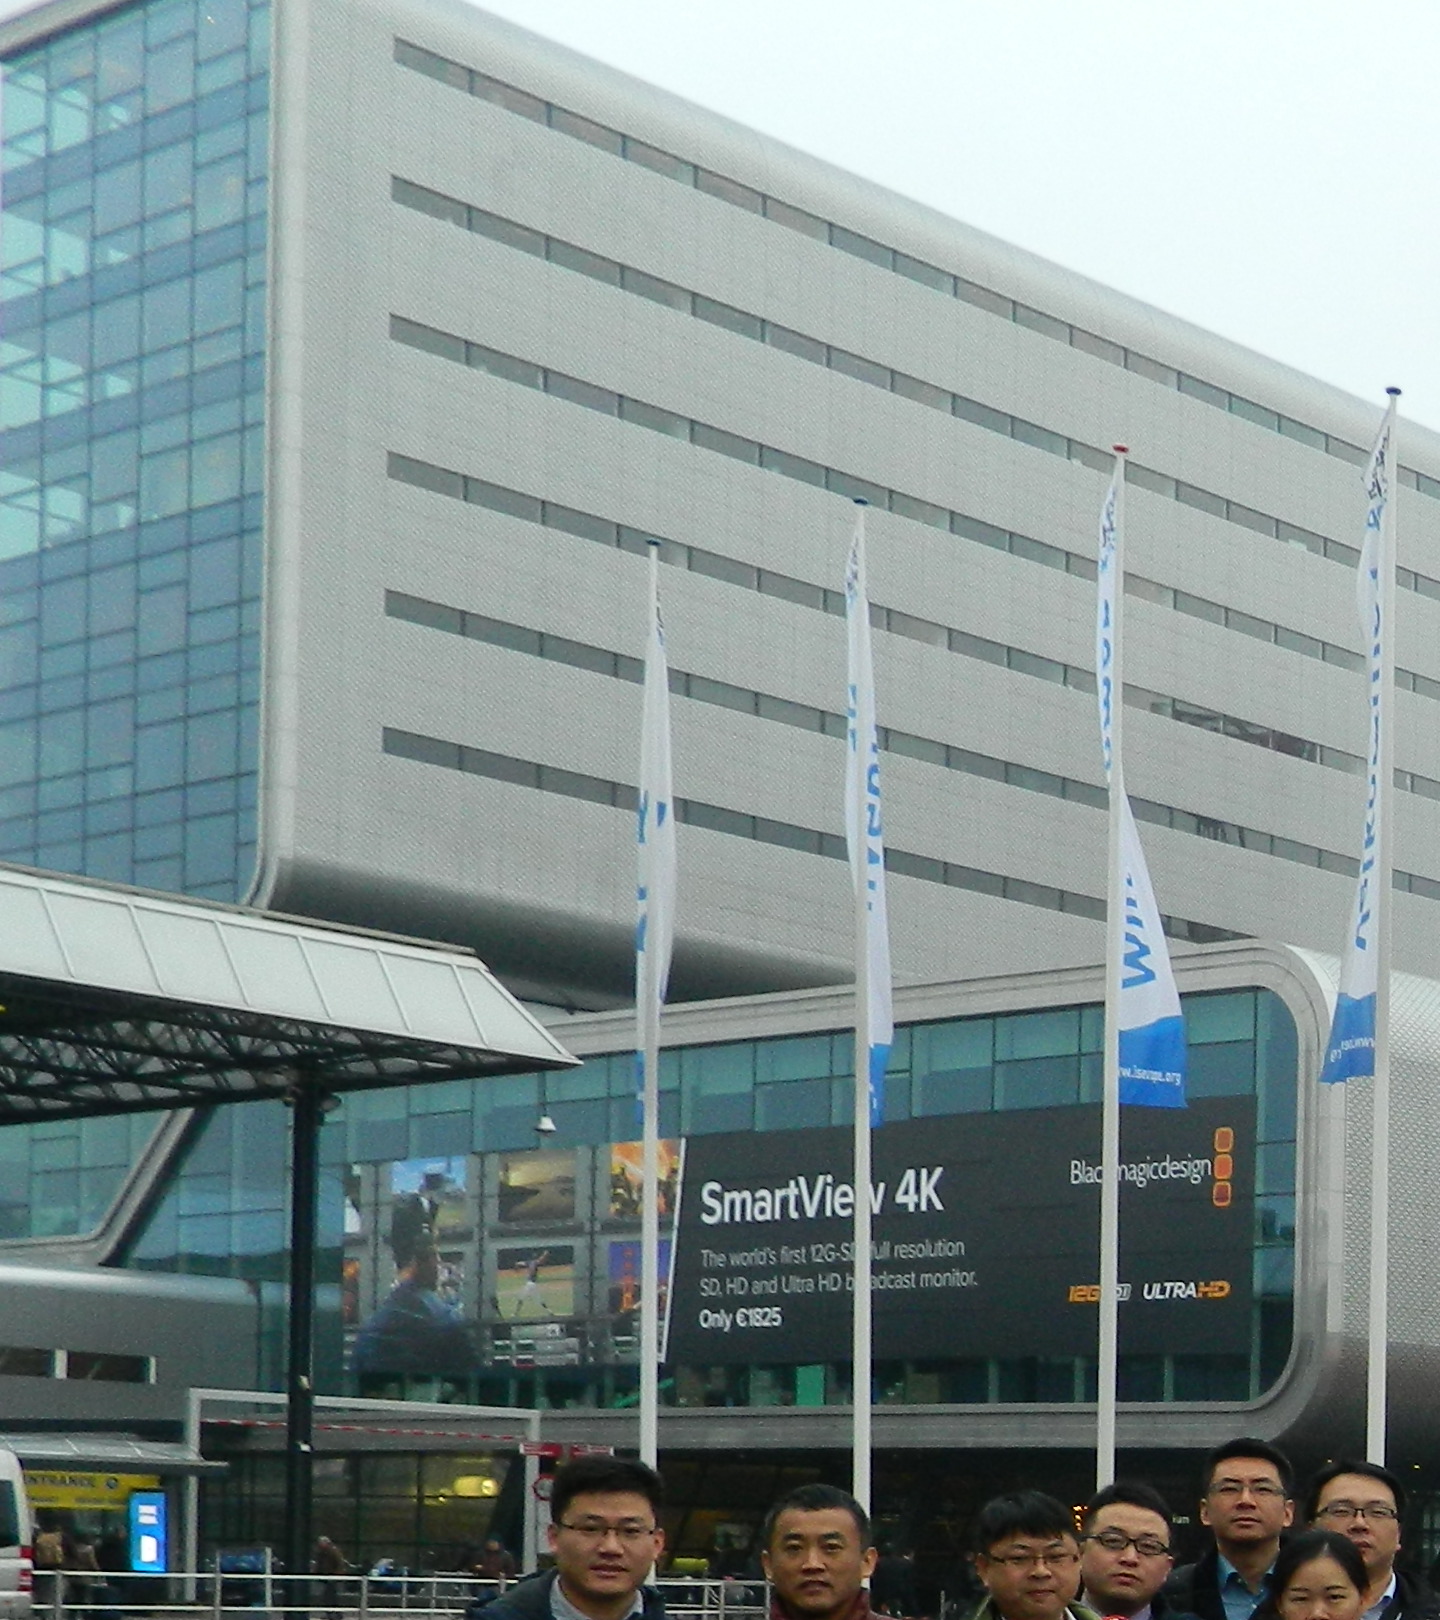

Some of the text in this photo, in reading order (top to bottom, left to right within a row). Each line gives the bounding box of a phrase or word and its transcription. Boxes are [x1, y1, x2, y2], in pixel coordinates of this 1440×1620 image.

[1070, 1153, 1212, 1188] Blacmagicdesign
[894, 1166, 945, 1213] 4K
[701, 1249, 725, 1268] The
[730, 1246, 776, 1267] world's
[779, 1245, 806, 1265] first
[893, 1237, 965, 1260] resolution
[726, 1275, 749, 1296] HD
[752, 1274, 777, 1295] and
[782, 1273, 814, 1293] Ultra
[818, 1272, 842, 1292] HD
[846, 1270, 916, 1292] badcast
[700, 1306, 783, 1333] Only €1825
